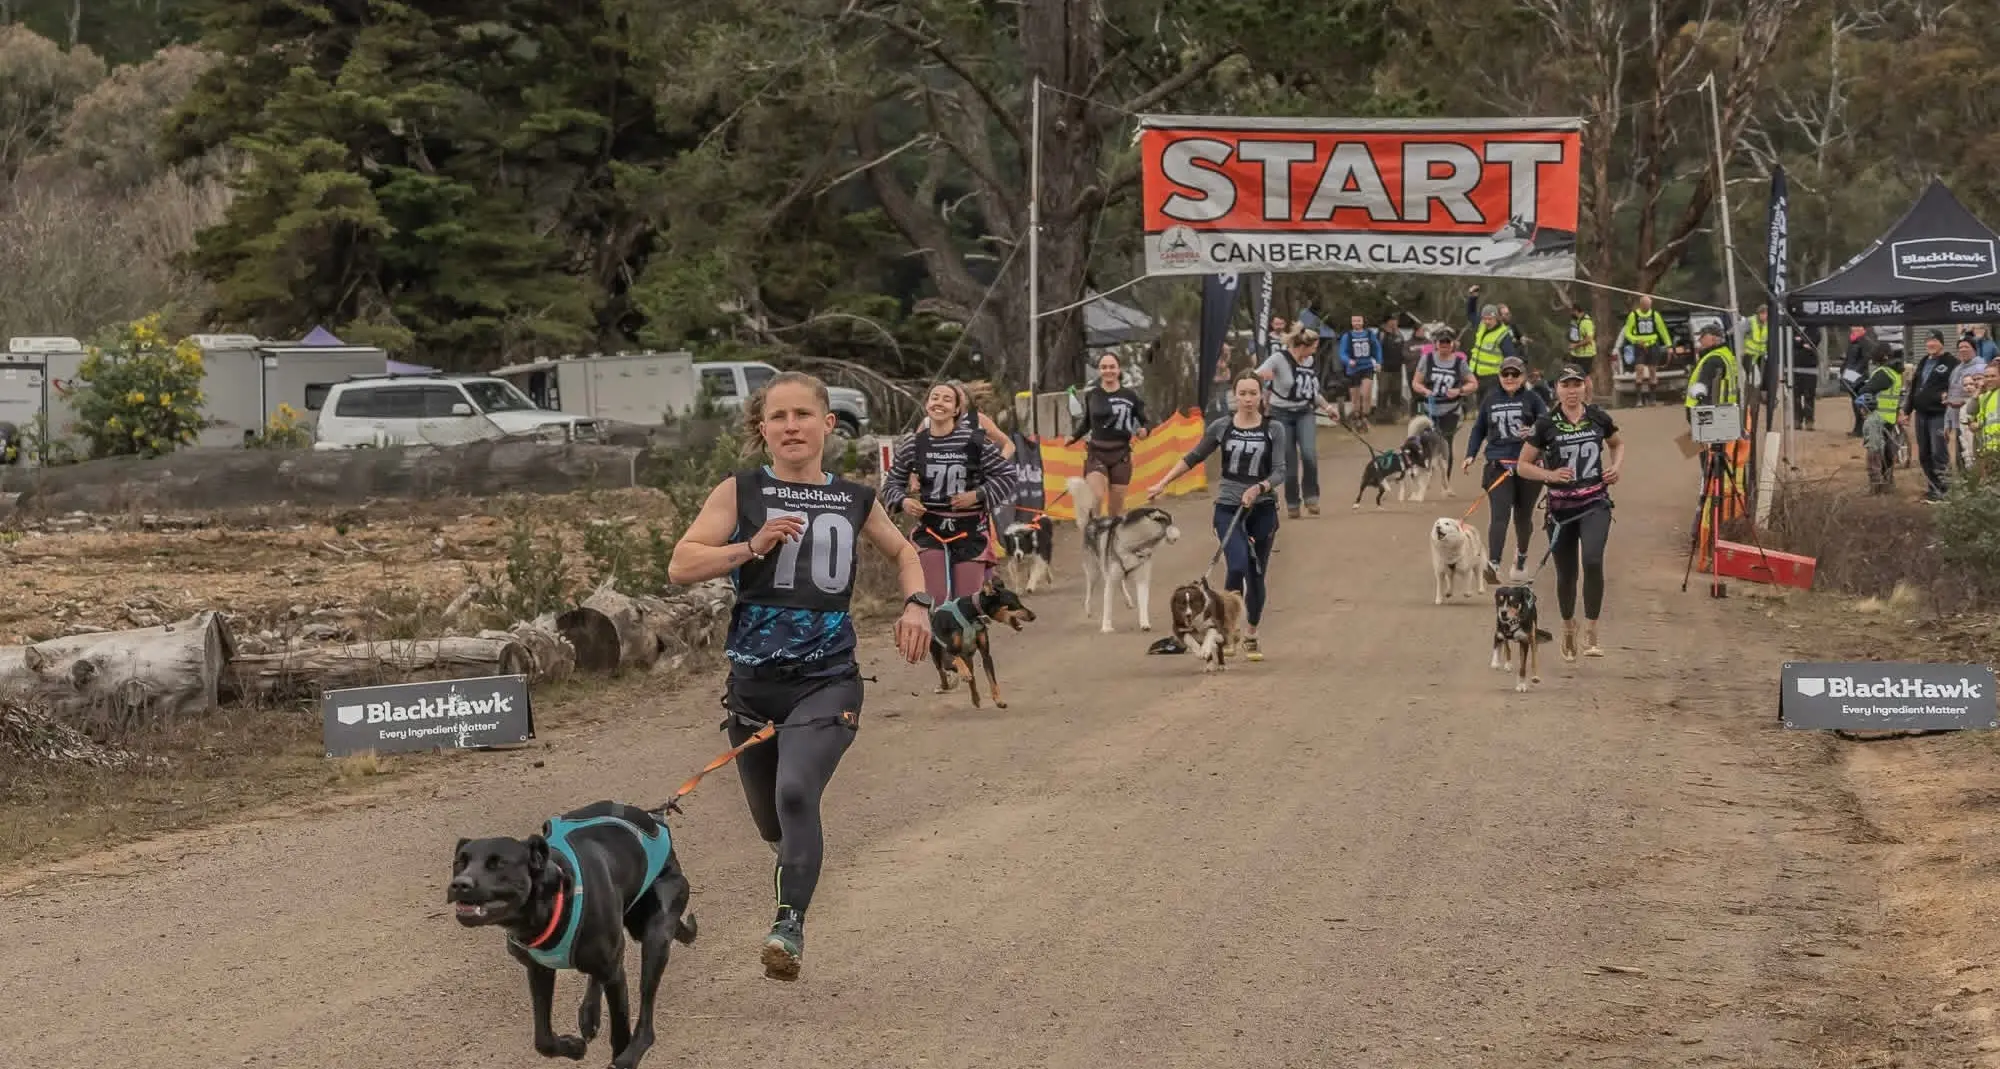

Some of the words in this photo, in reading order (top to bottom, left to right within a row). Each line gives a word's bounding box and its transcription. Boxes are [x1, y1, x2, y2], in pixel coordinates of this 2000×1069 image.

[1160, 137, 1565, 224] START
[1209, 242, 1361, 264] CANBERRA
[1368, 243, 1482, 266] CLASSIC
[1902, 251, 1987, 264] BlackHawk
[1820, 301, 1904, 315] BlackHawk
[1951, 301, 1983, 315] Every
[1491, 410, 1526, 439] 75
[1225, 440, 1265, 476] 77
[1560, 441, 1600, 480] 72
[926, 463, 968, 499] 76
[776, 486, 853, 503] BlackHawk
[766, 507, 854, 594] 70
[1828, 676, 1982, 699] BlackHawk
[366, 691, 512, 724] BlackHawk
[1842, 705, 1871, 716] Every
[1872, 705, 1925, 716] Ingredient
[1925, 705, 1968, 715] Matters
[379, 728, 407, 740] Every
[408, 723, 459, 739] Ingredient
[459, 722, 499, 733] Matters
